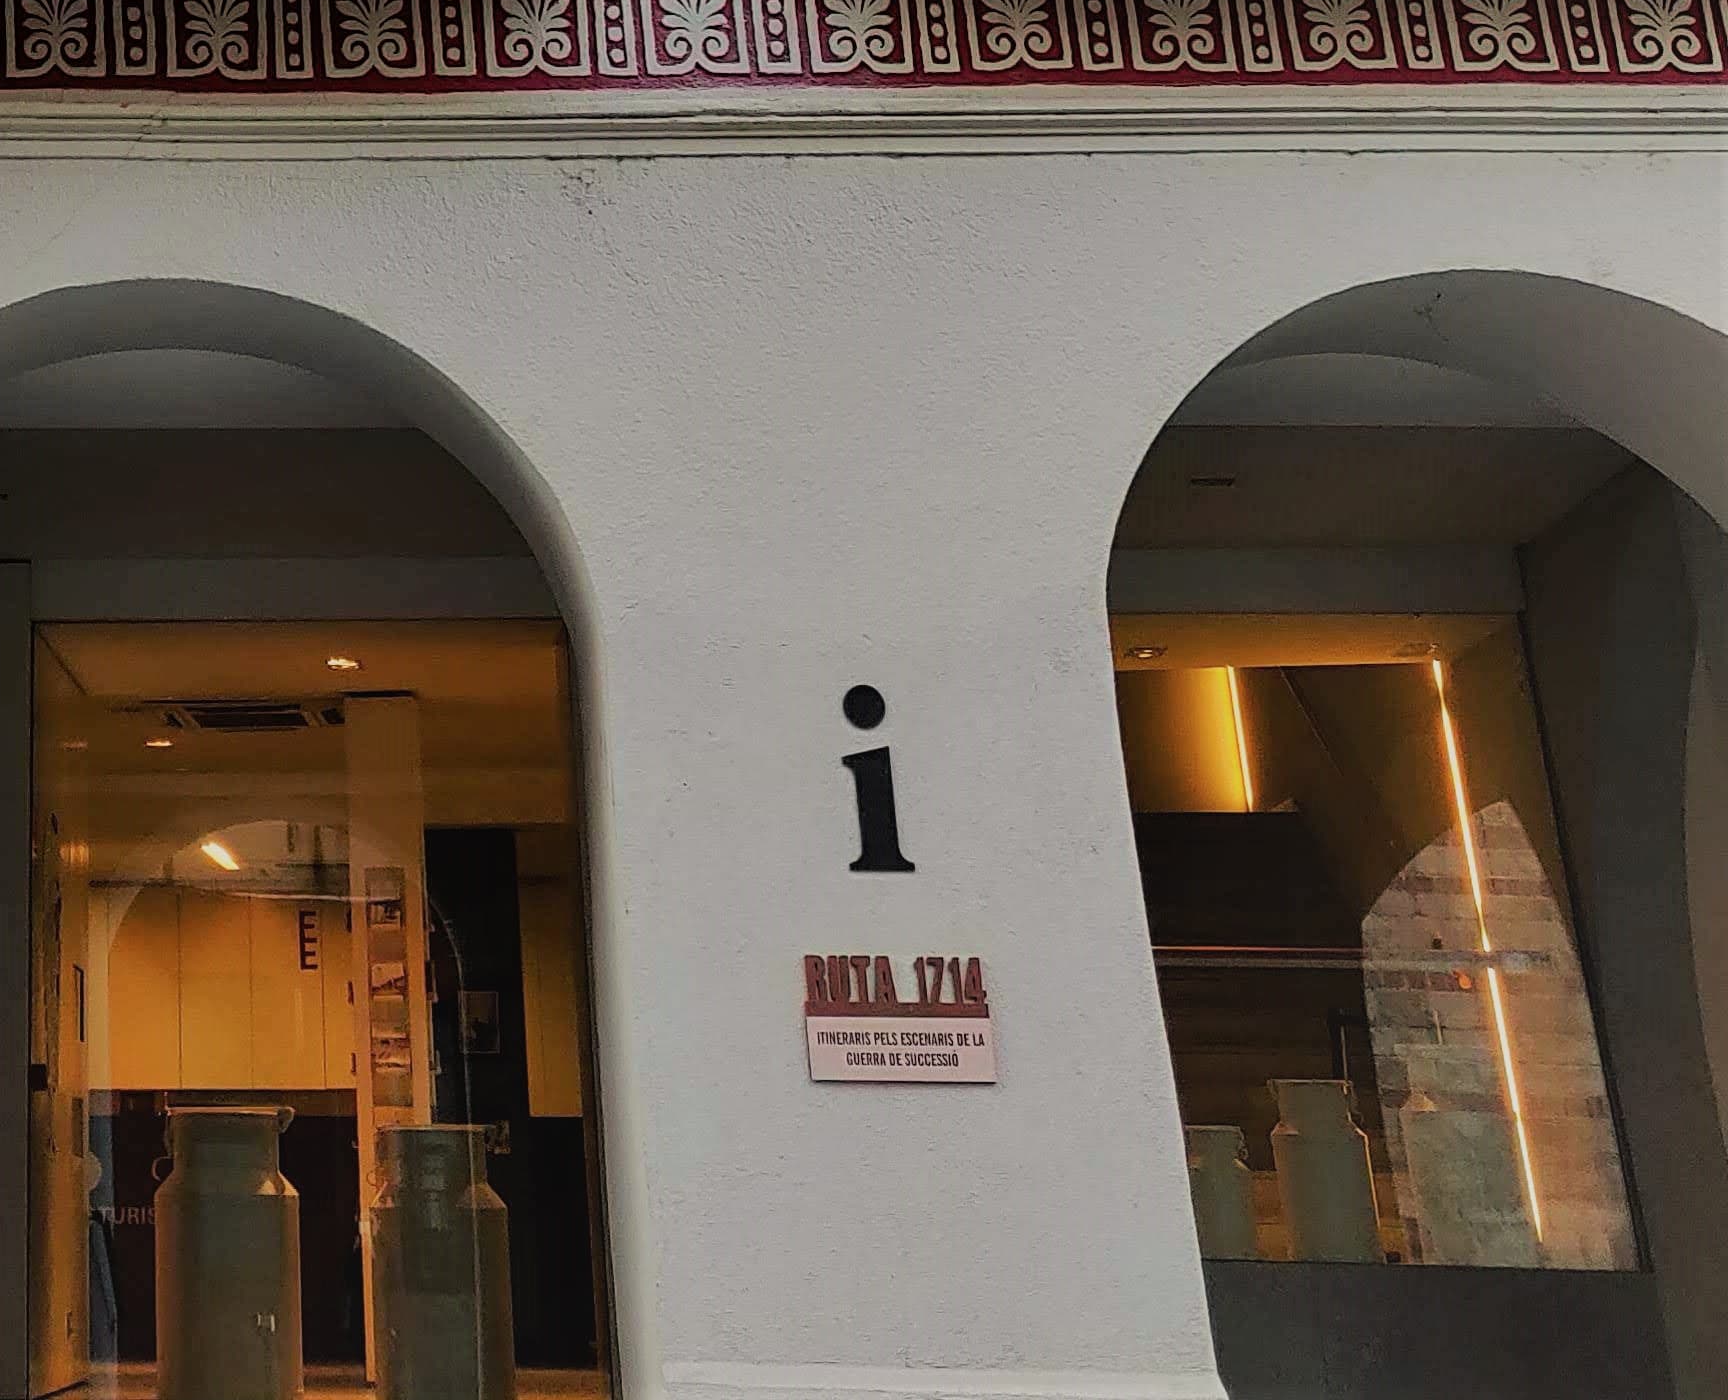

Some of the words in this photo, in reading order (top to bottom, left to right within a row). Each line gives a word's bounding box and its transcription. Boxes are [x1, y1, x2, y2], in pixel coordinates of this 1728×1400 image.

[841, 684, 916, 872] i
[804, 955, 897, 1005] RUTA
[913, 957, 988, 1005] 1714
[817, 1031, 872, 1046] ITINERARIS
[874, 1032, 898, 1046] PELS
[901, 1032, 954, 1047] ESCENARIS
[957, 1033, 970, 1046] DE
[973, 1033, 985, 1047] LA
[846, 1052, 887, 1067] GUERRA
[889, 1053, 902, 1066] DE
[904, 1049, 959, 1068] SUCCESSIÓ
